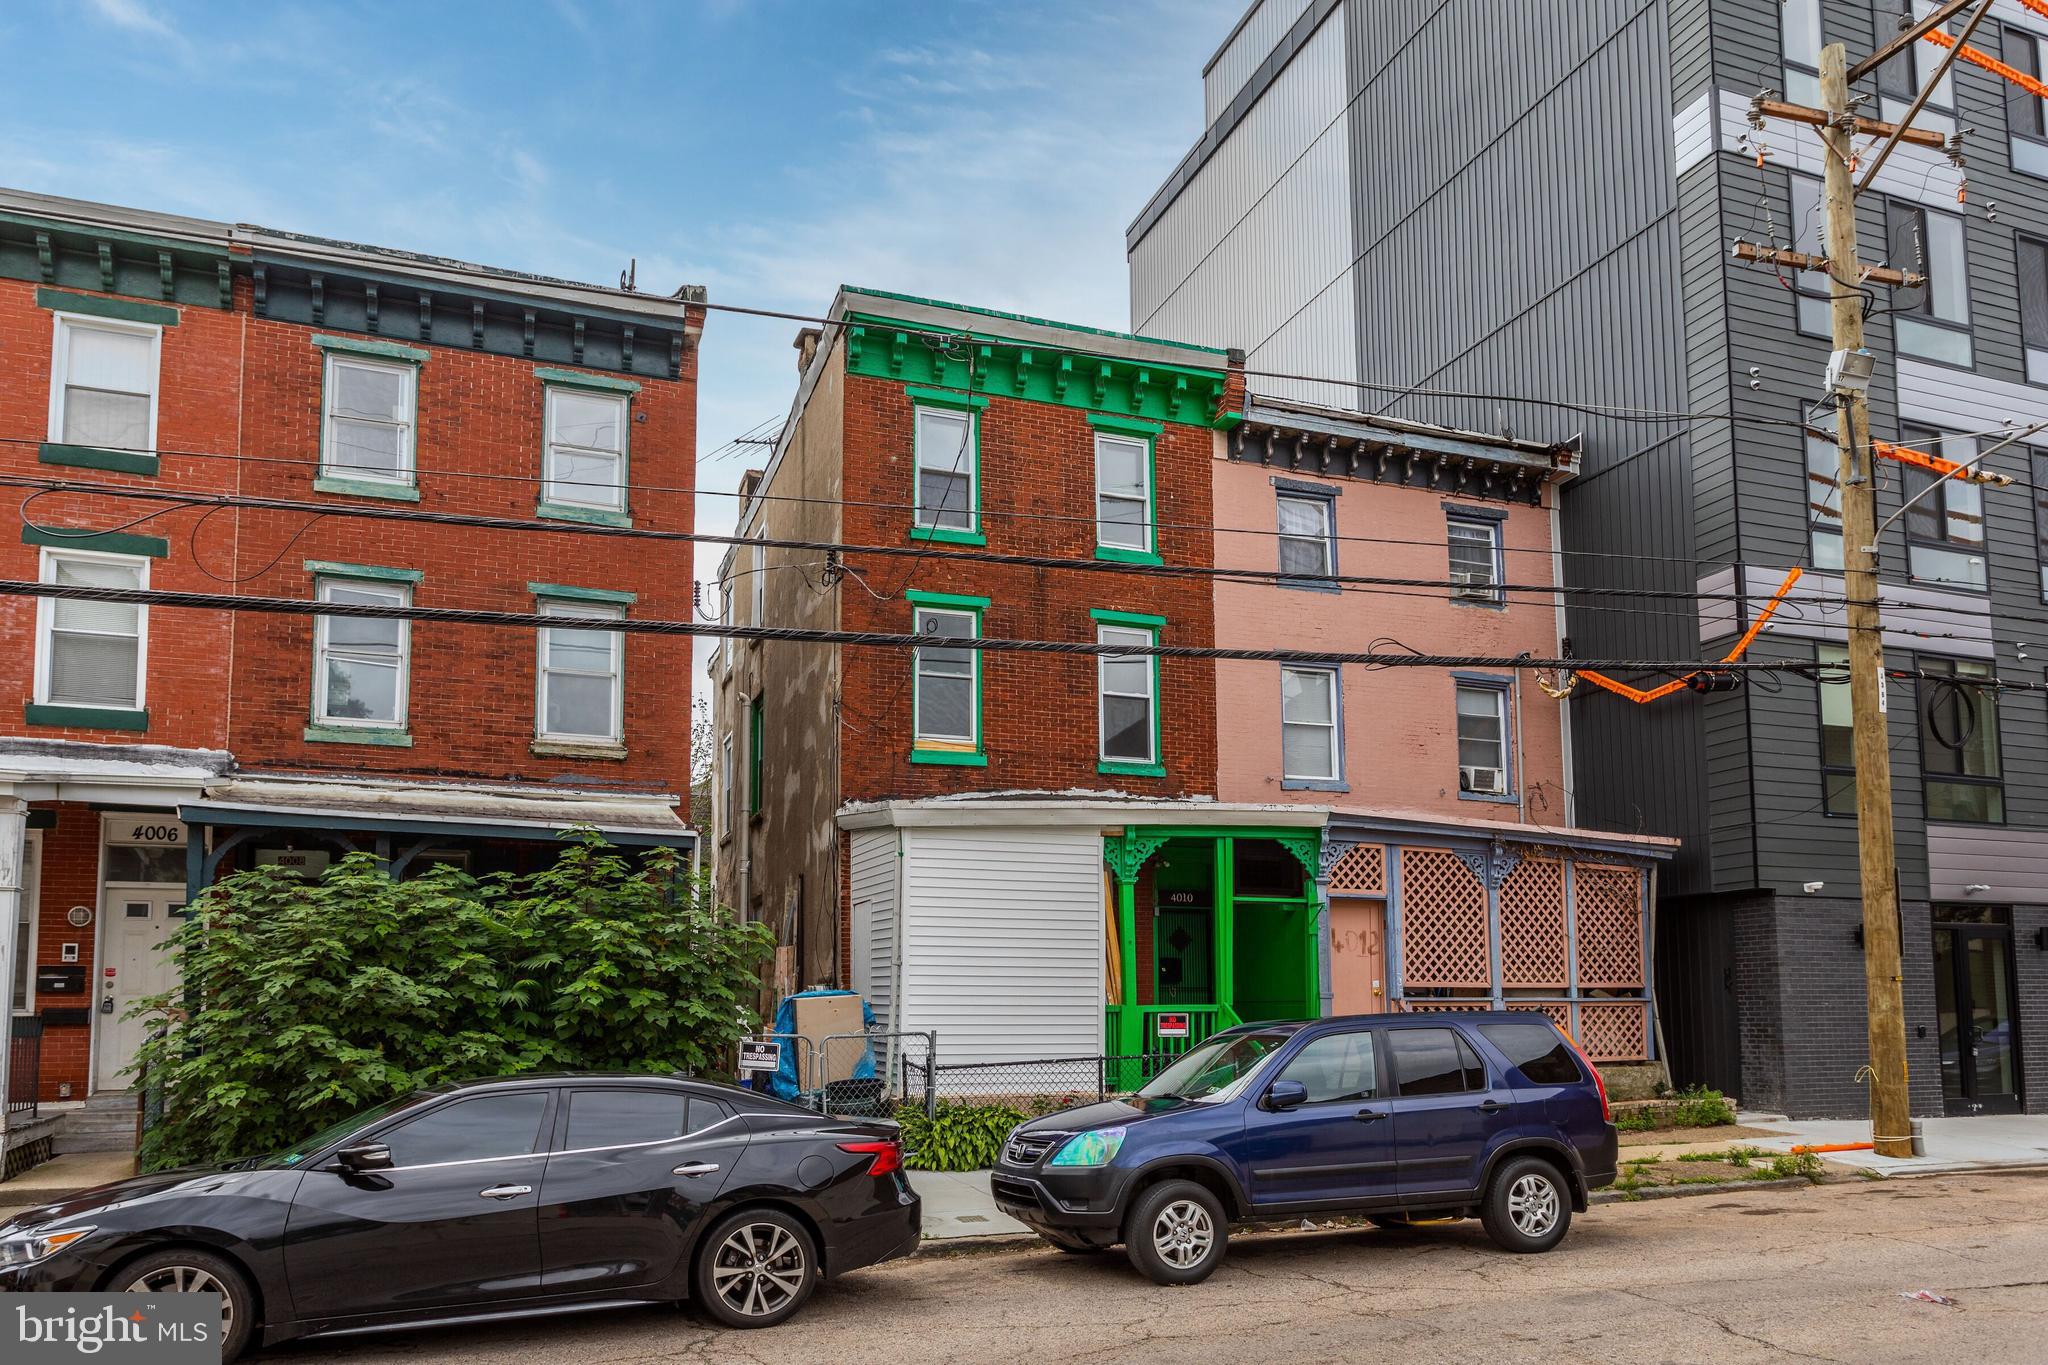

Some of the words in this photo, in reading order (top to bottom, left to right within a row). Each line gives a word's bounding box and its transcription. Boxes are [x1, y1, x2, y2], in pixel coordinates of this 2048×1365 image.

[132, 825, 178, 842] 4006
[1170, 892, 1194, 903] 4010
[755, 1045, 765, 1053] NO
[743, 1052, 777, 1062] TRESPASSING
